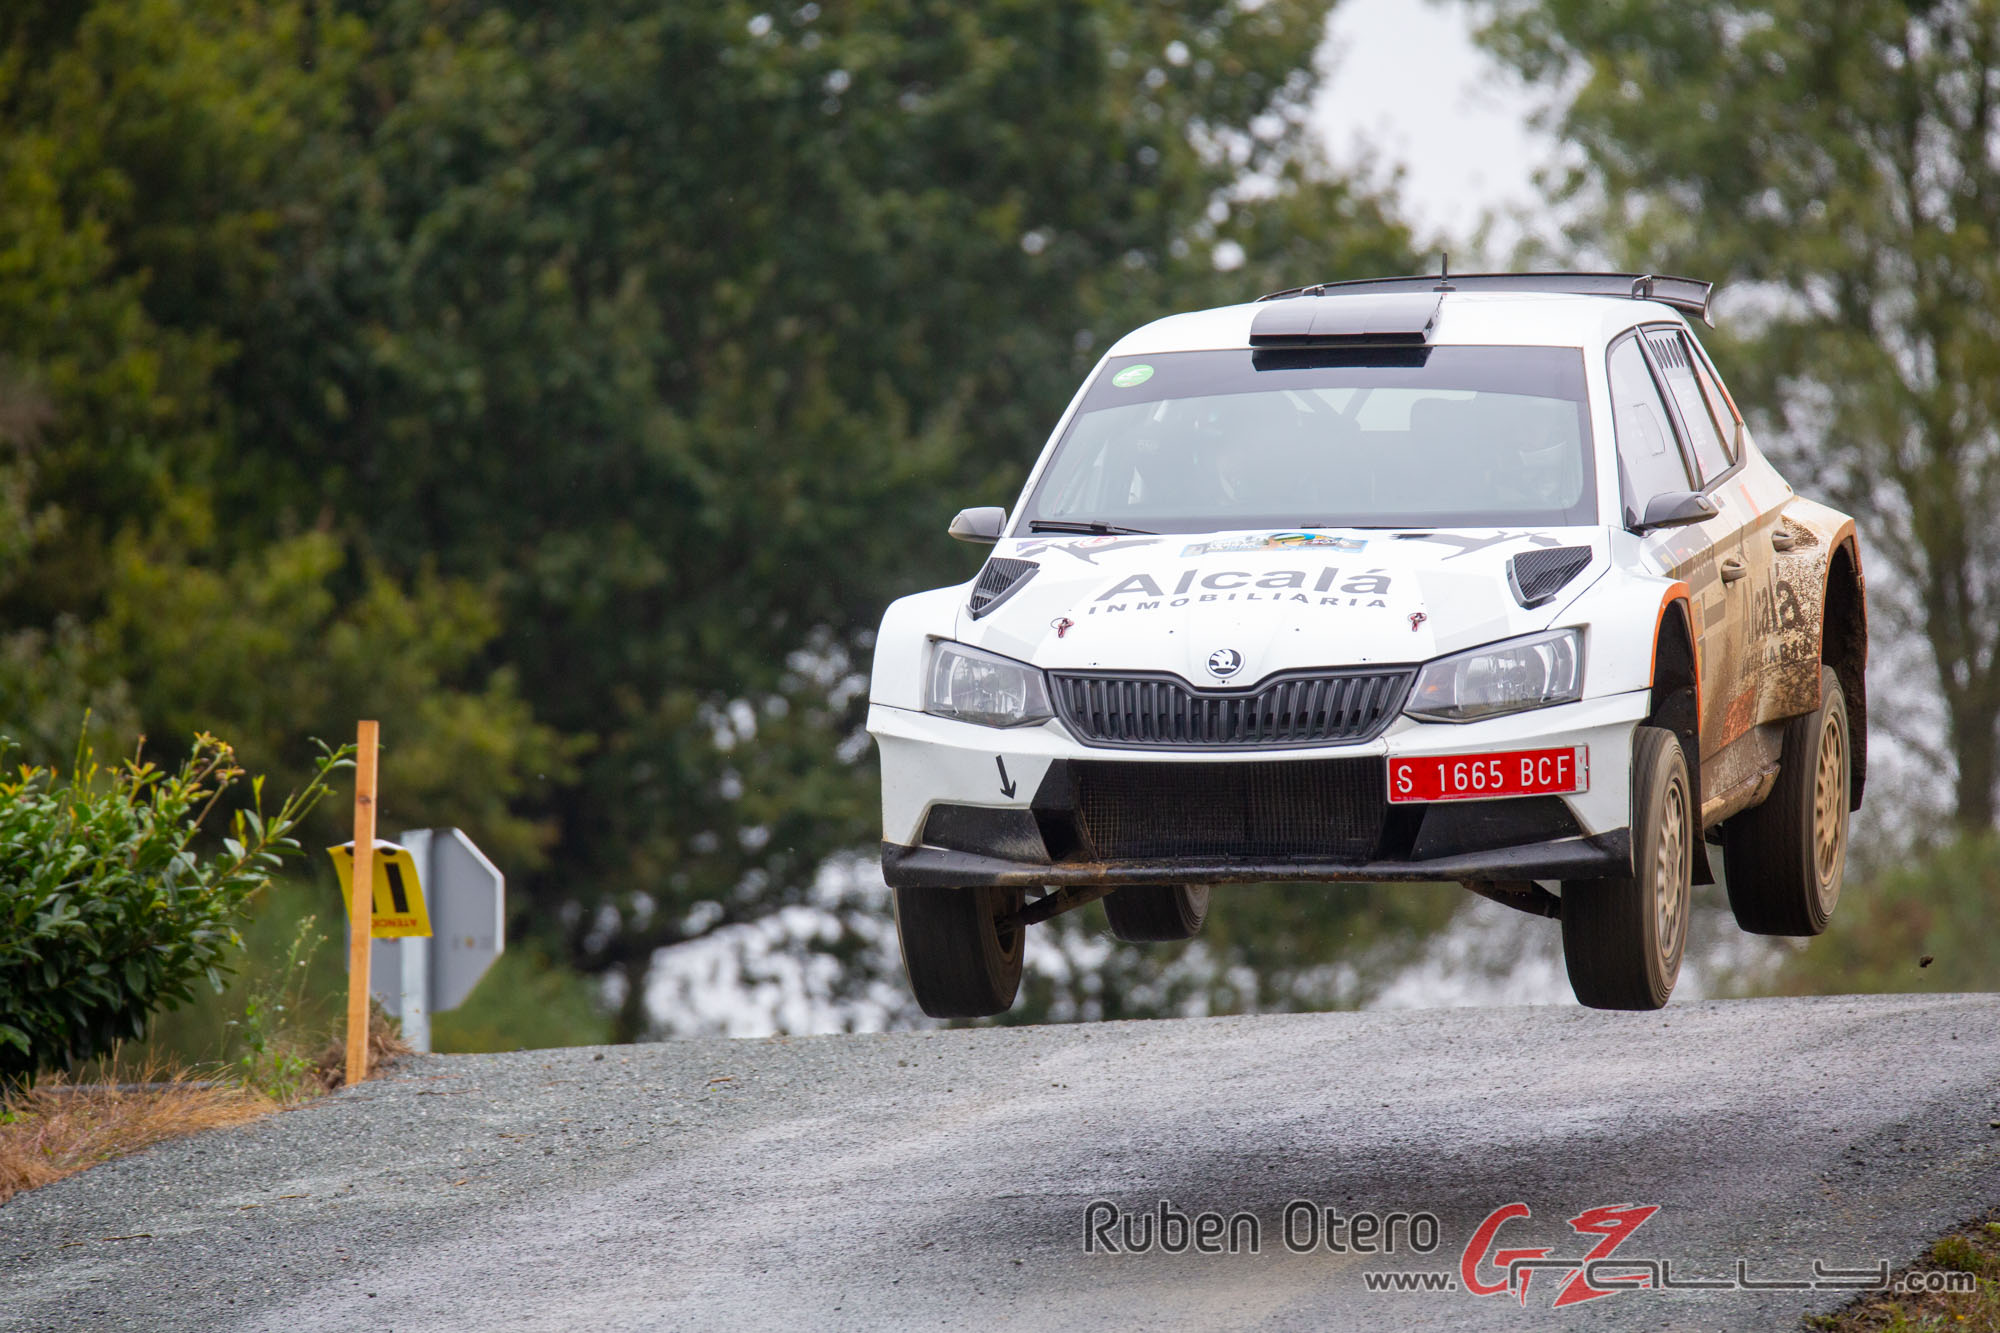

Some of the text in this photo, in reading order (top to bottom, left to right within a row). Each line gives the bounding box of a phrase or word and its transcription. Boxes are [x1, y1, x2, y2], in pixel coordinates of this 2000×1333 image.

[1095, 567, 1391, 602] Alcalá
[1089, 593, 1386, 614] INMOBILIARIA
[1398, 755, 1570, 793] S 1665 BCF
